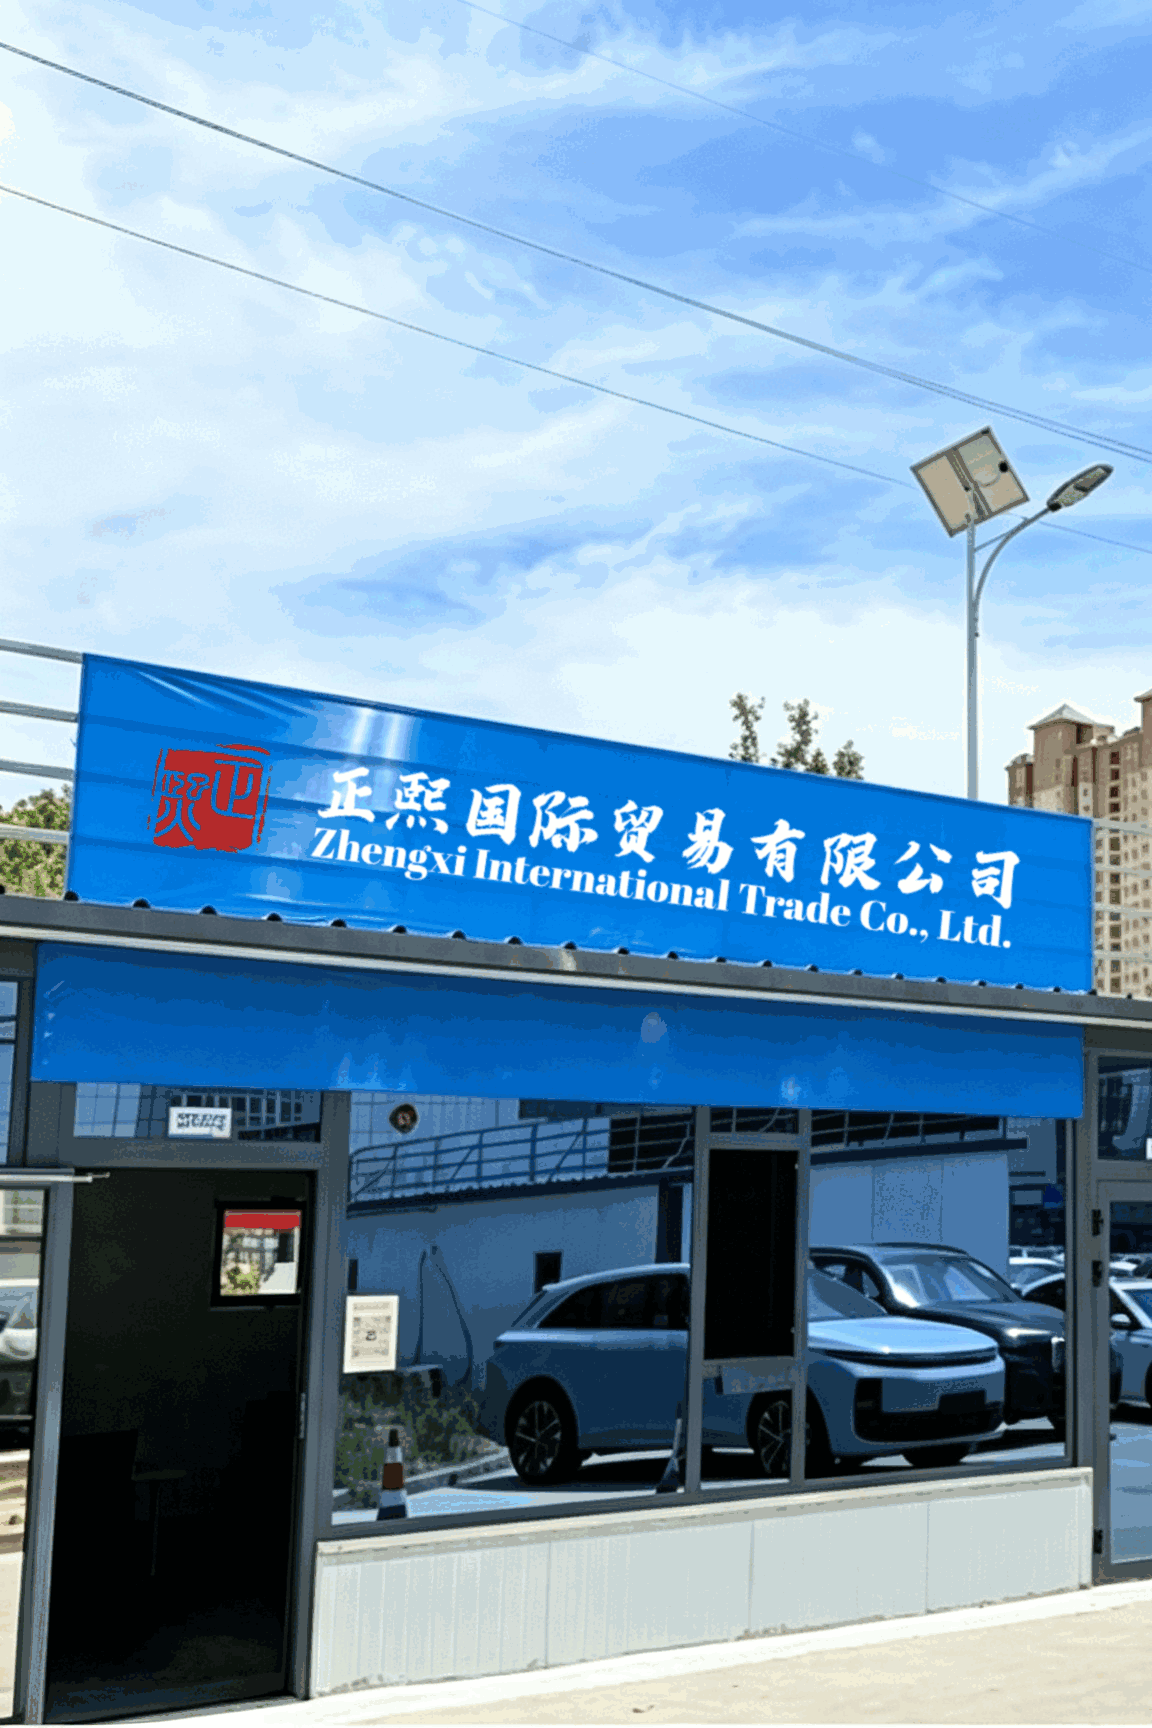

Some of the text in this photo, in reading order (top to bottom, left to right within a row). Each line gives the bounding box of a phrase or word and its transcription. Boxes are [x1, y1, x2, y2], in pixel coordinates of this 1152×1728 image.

[311, 827, 1012, 949] Zhengxi International Trade Co., Ltd.
[315, 767, 1021, 910] 正熙国际贸易有限公司
